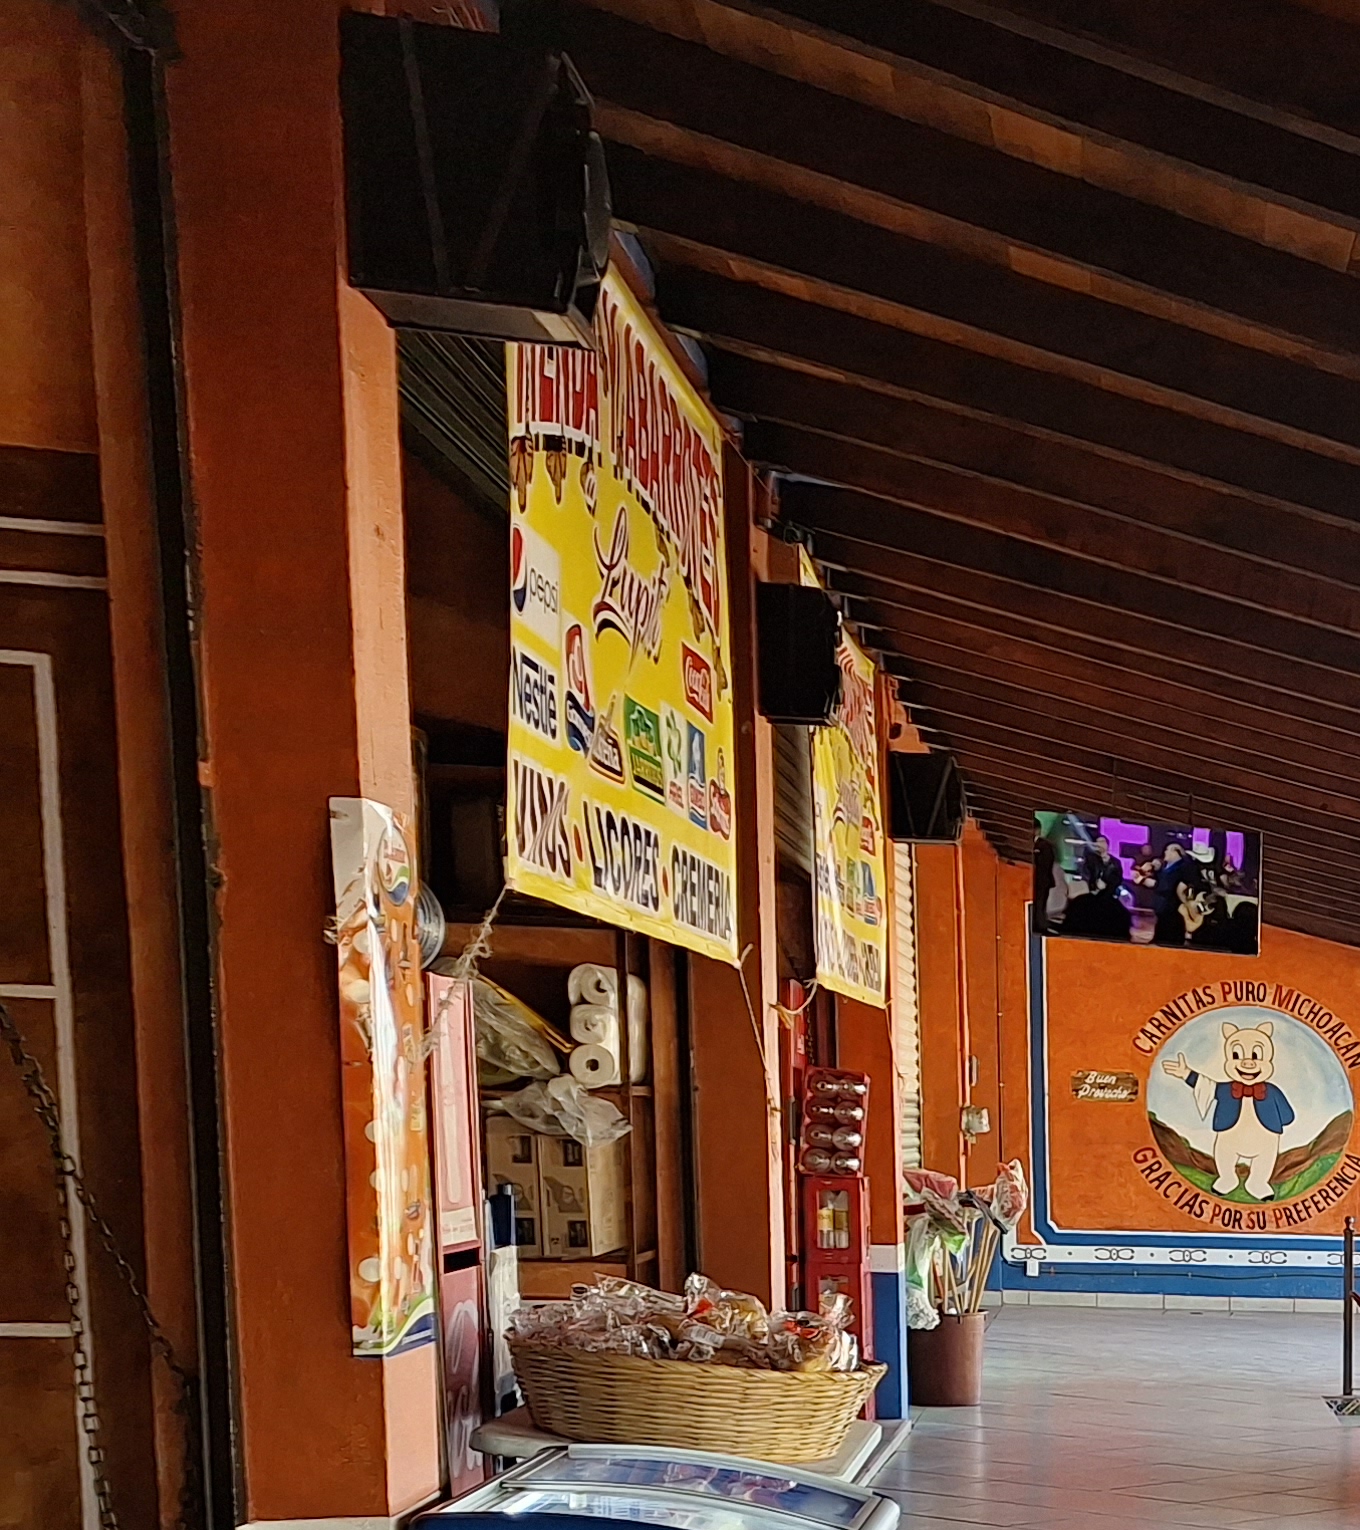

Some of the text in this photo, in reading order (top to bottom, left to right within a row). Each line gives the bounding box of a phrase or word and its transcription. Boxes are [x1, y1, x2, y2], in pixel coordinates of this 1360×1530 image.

[529, 565, 559, 615] pepsi
[511, 644, 558, 742] Nestlé
[582, 799, 660, 913] LICORES
[671, 843, 733, 941] CREMERIA
[1132, 985, 1216, 1054] CARNITAS
[1220, 980, 1267, 1003] PURO
[1085, 1070, 1117, 1084] Buen
[1132, 1146, 1210, 1219] GRACIAS
[1209, 1203, 1244, 1231] POR
[1246, 1209, 1267, 1231] SU
